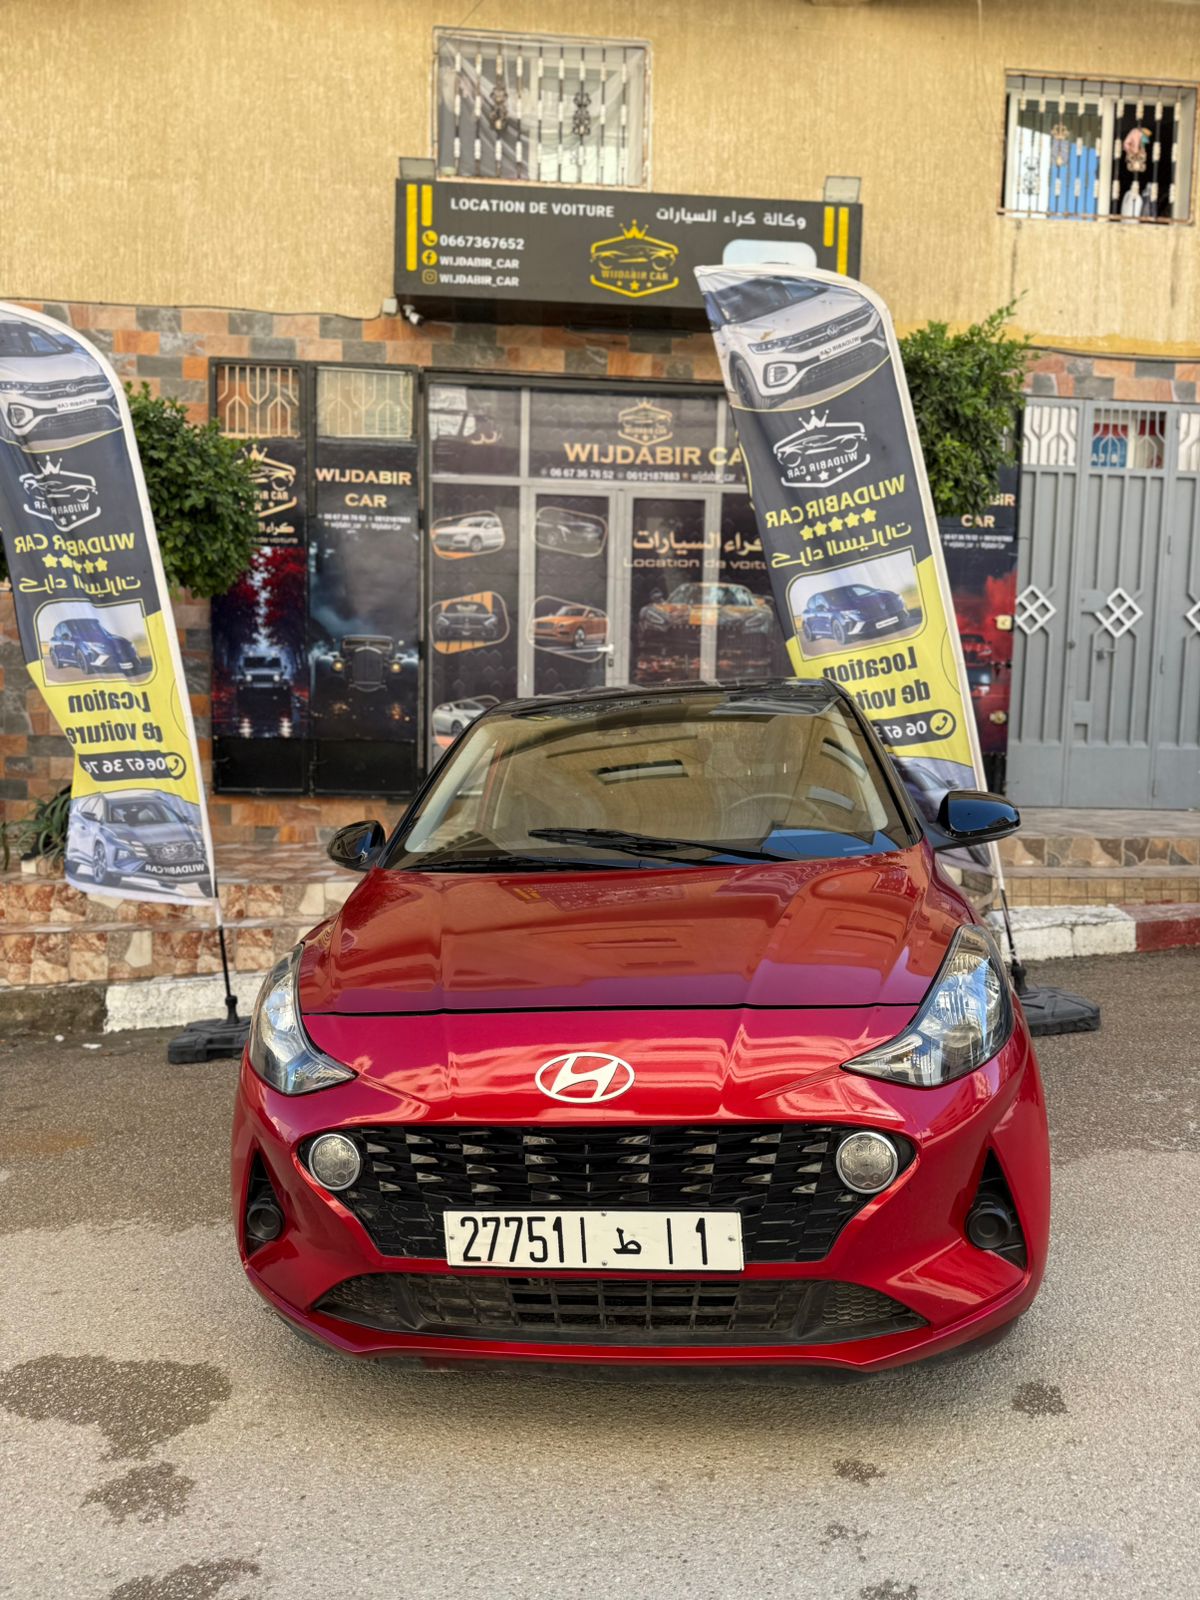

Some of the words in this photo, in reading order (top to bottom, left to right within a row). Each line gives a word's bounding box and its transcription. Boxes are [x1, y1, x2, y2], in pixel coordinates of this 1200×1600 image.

[450, 197, 526, 213] LOCATION
[529, 201, 548, 214] DE
[551, 202, 615, 218] VOITURE
[655, 207, 717, 224] السيارات
[723, 210, 756, 227] كراء
[763, 212, 807, 230] وكالة
[439, 234, 525, 250] 0667367652
[649, 270, 669, 281] CAR
[563, 442, 702, 466] WIJDABIR
[708, 446, 743, 466] CA
[315, 468, 412, 485] WIJDABIR
[344, 492, 387, 508] CAR
[633, 530, 721, 555] السيارات
[623, 557, 700, 568] Location
[704, 559, 726, 569] de
[460, 1216, 565, 1263] 27751
[695, 1217, 708, 1265] 1
